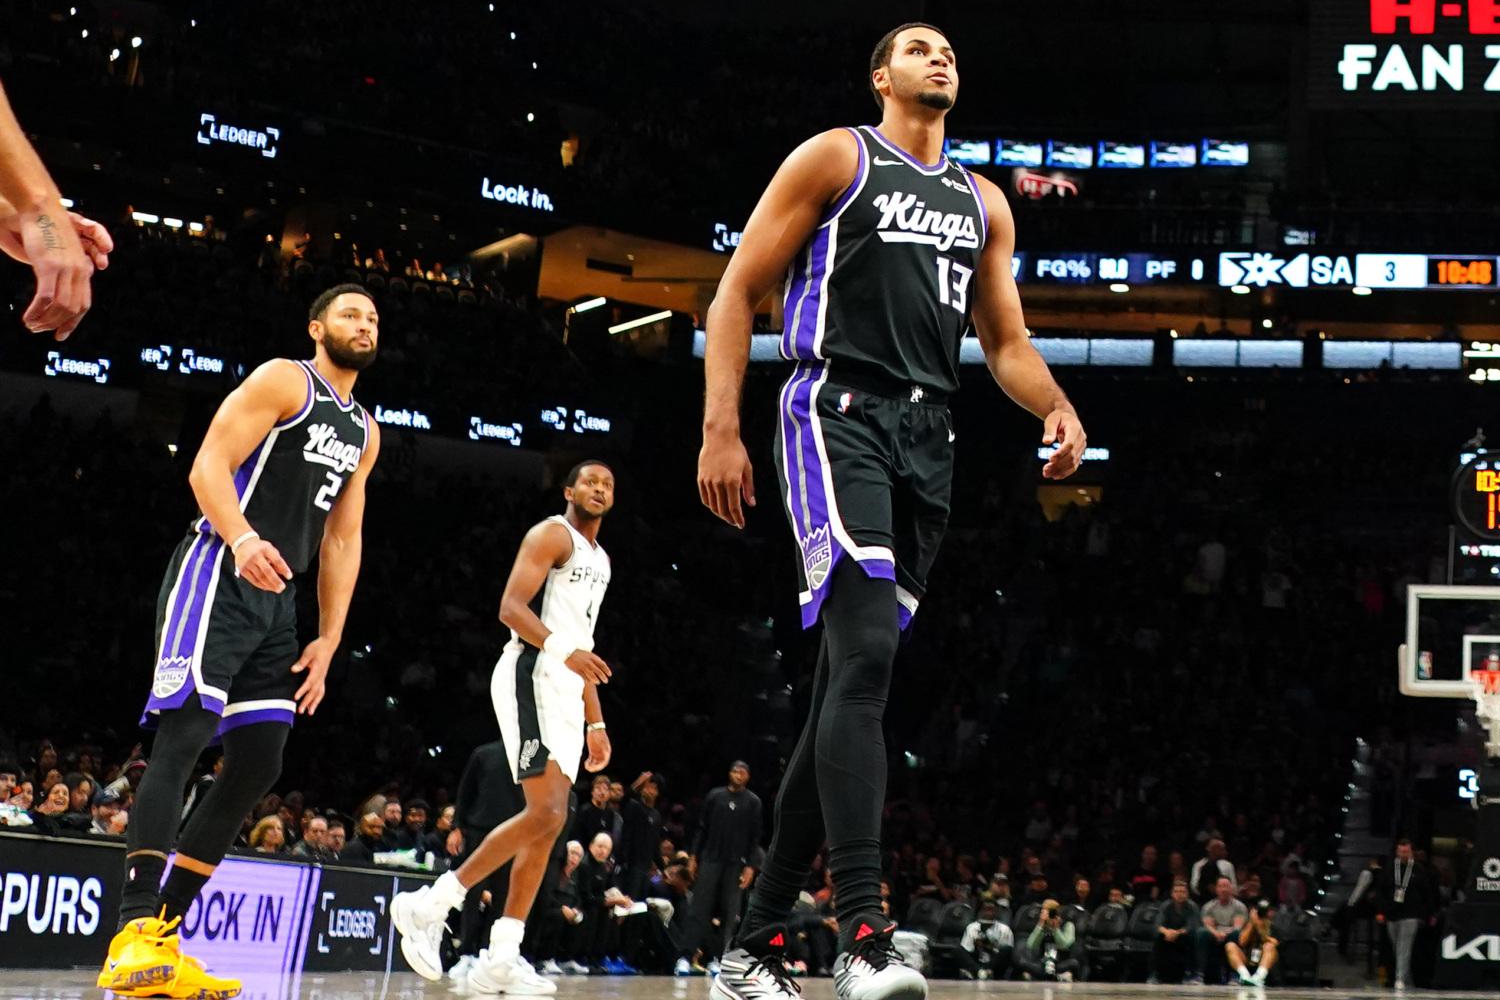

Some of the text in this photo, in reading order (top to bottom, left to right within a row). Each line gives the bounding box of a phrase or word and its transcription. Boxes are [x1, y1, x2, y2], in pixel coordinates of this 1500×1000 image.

[1338, 44, 1464, 91] FAN
[210, 123, 268, 149] LEDGER
[482, 177, 554, 212] Lock in.
[873, 191, 979, 251] Kings
[936, 256, 973, 314] 13
[1037, 259, 1091, 278] FG%
[1146, 261, 1177, 278] PF
[1311, 256, 1396, 284] SA 3
[54, 357, 99, 377] LEDGER
[375, 405, 412, 427] Lock
[303, 423, 361, 473] Kings
[0, 872, 102, 937] PURS
[180, 889, 284, 943] OCK IN
[328, 908, 376, 940] LEDGER
